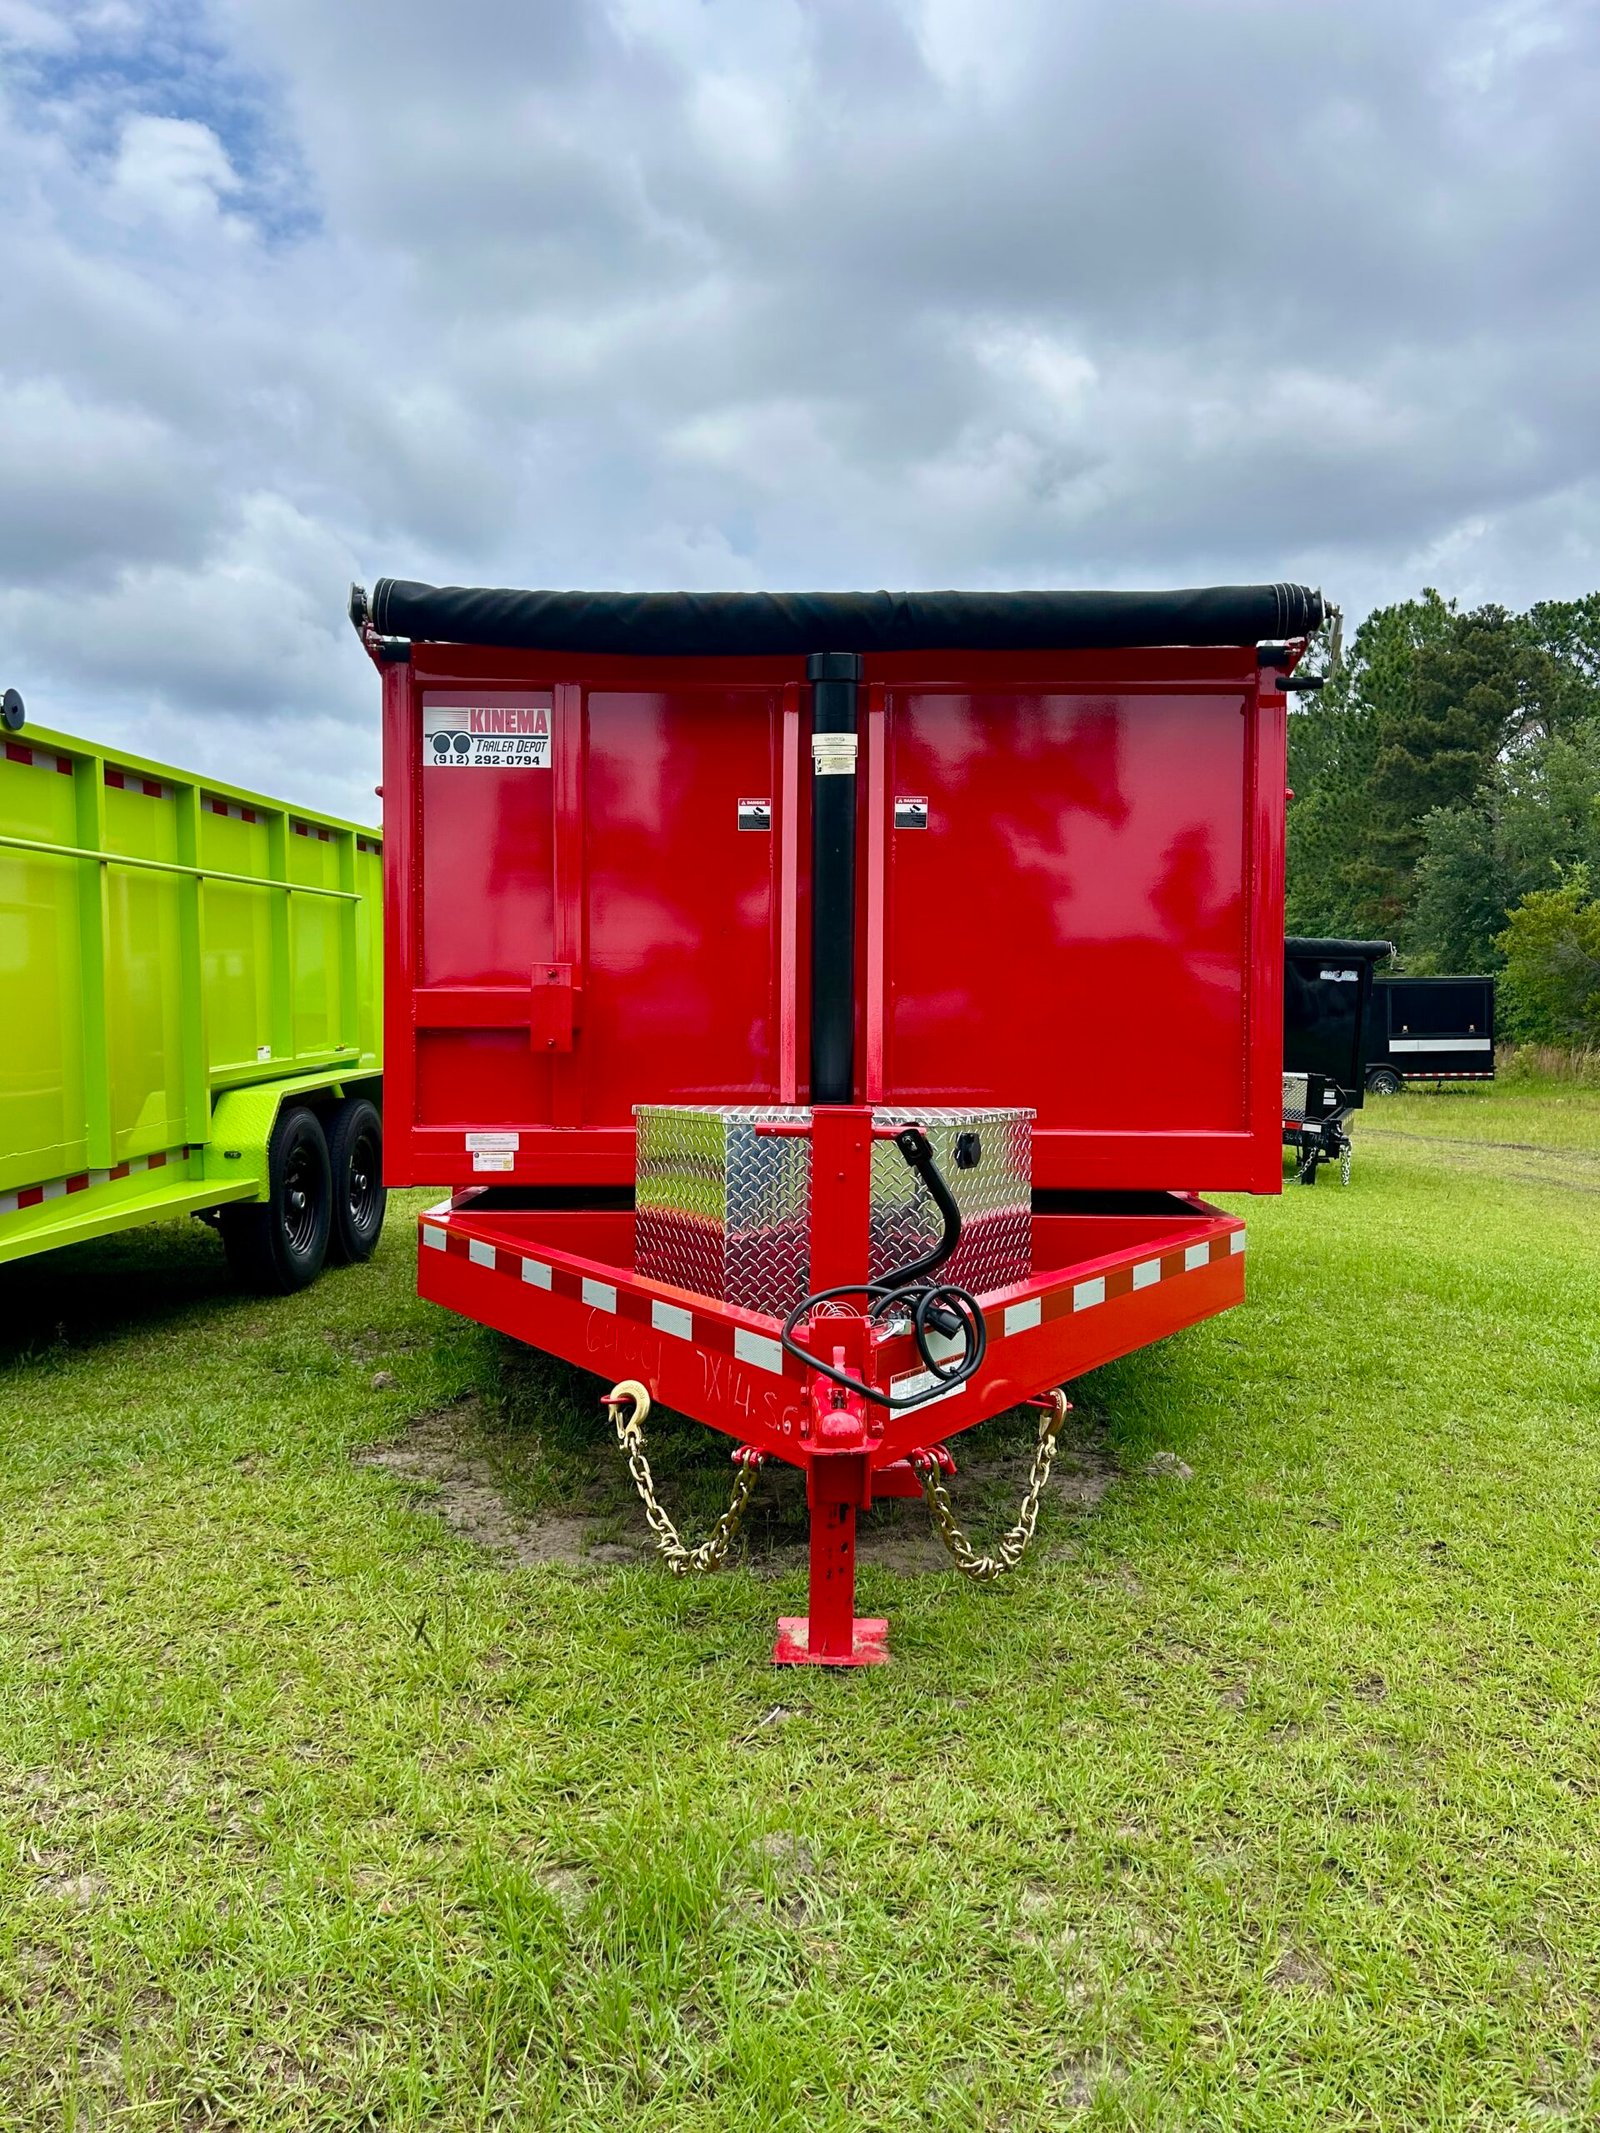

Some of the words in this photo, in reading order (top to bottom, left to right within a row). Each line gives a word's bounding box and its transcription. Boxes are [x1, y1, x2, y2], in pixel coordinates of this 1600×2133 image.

[469, 708, 548, 734] KINEMA
[476, 739, 515, 753] TRAILER
[516, 739, 547, 753] DEPOT
[433, 754, 469, 766] (912)
[474, 754, 540, 766] 292-0794
